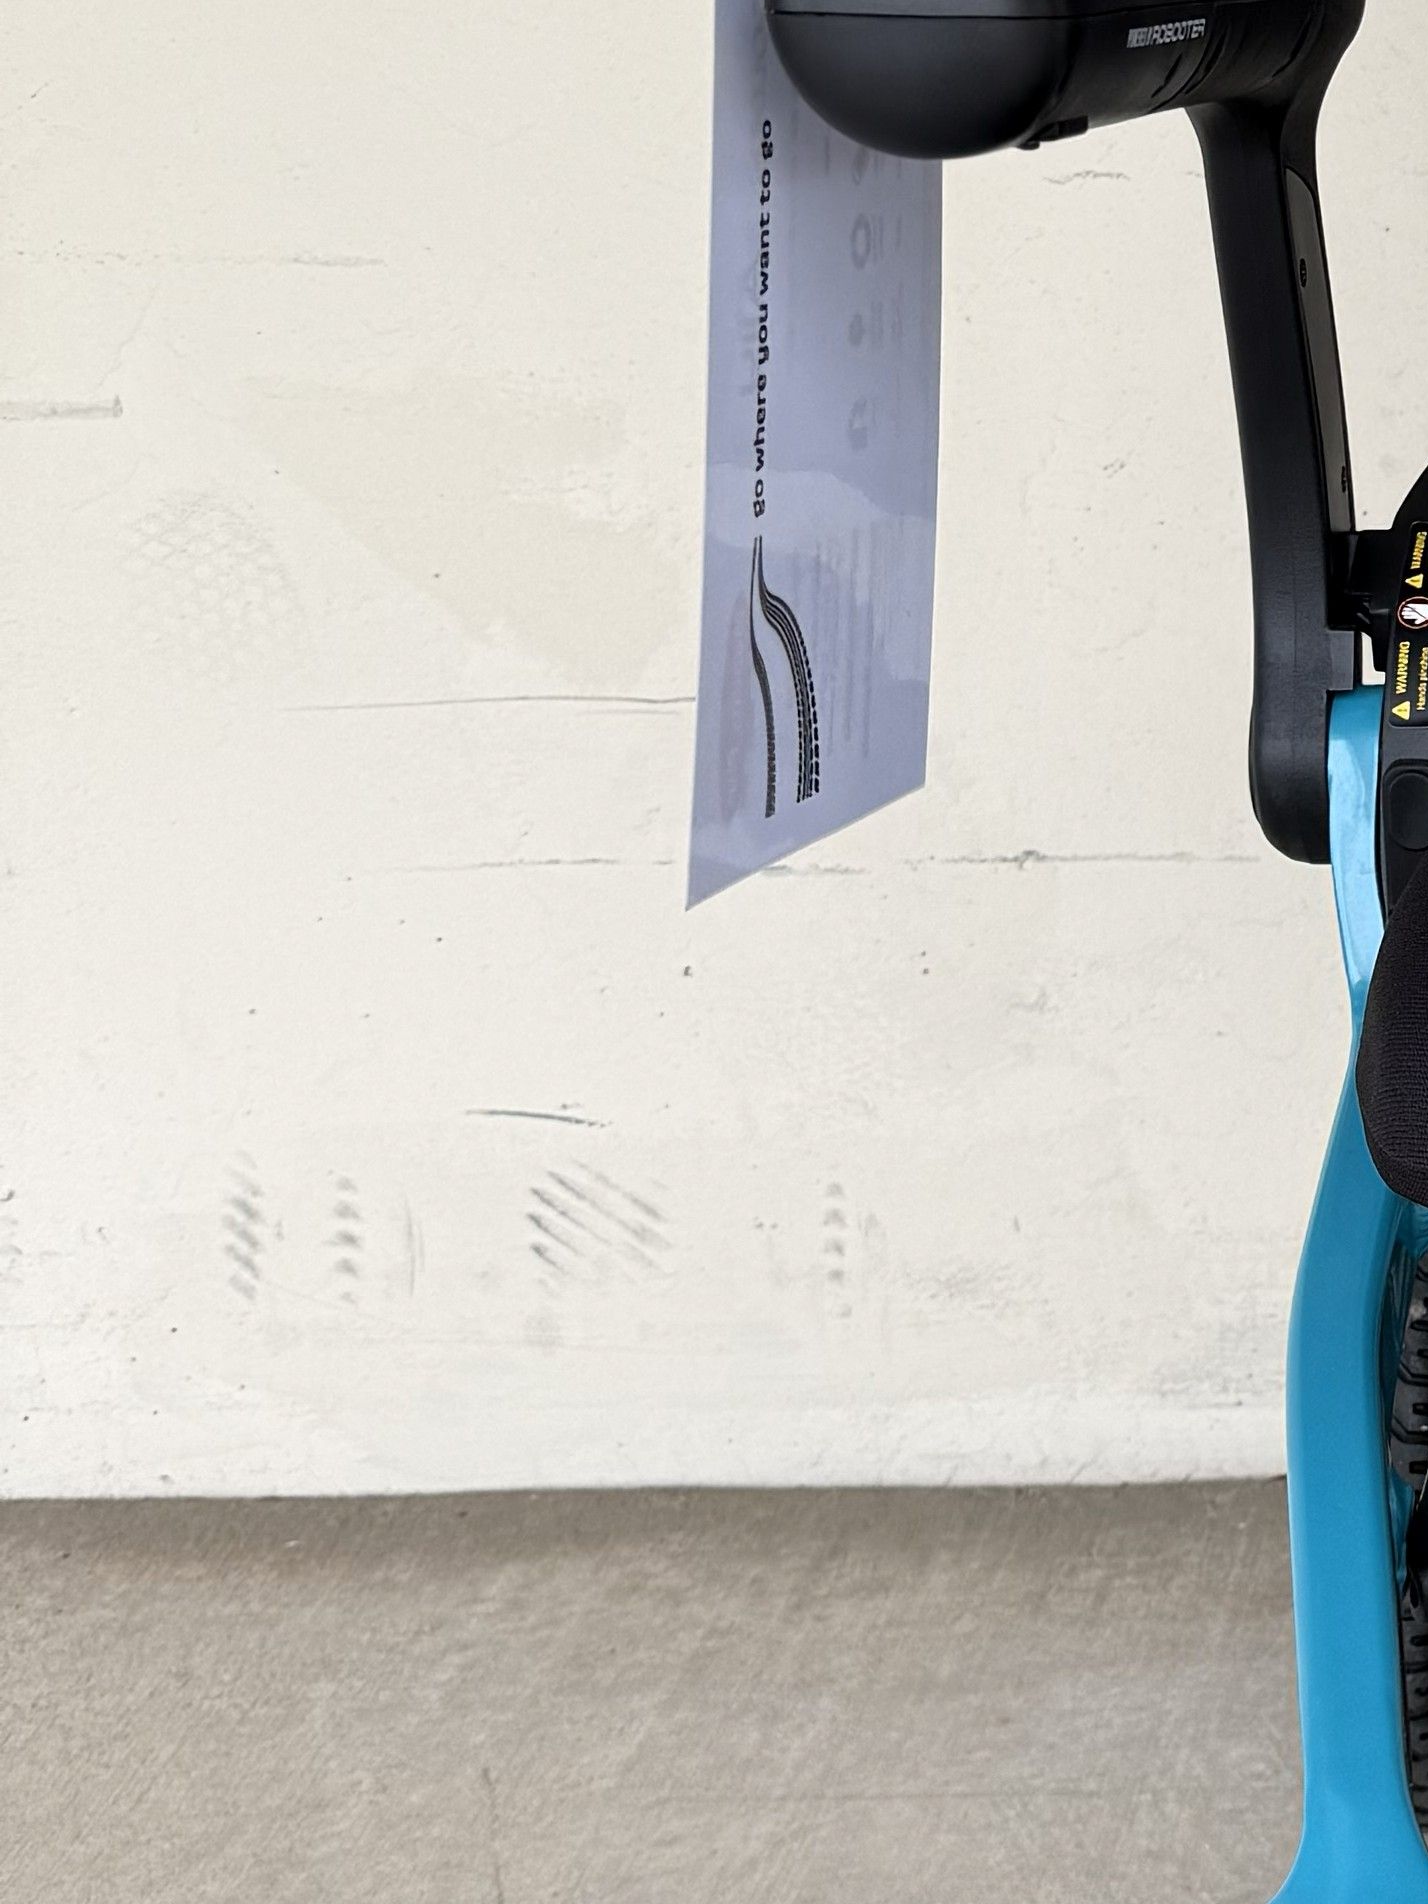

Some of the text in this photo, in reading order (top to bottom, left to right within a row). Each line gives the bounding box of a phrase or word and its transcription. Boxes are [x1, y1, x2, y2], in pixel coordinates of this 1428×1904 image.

[752, 119, 774, 518] go where you want to go
[1395, 641, 1411, 694] WARNING
